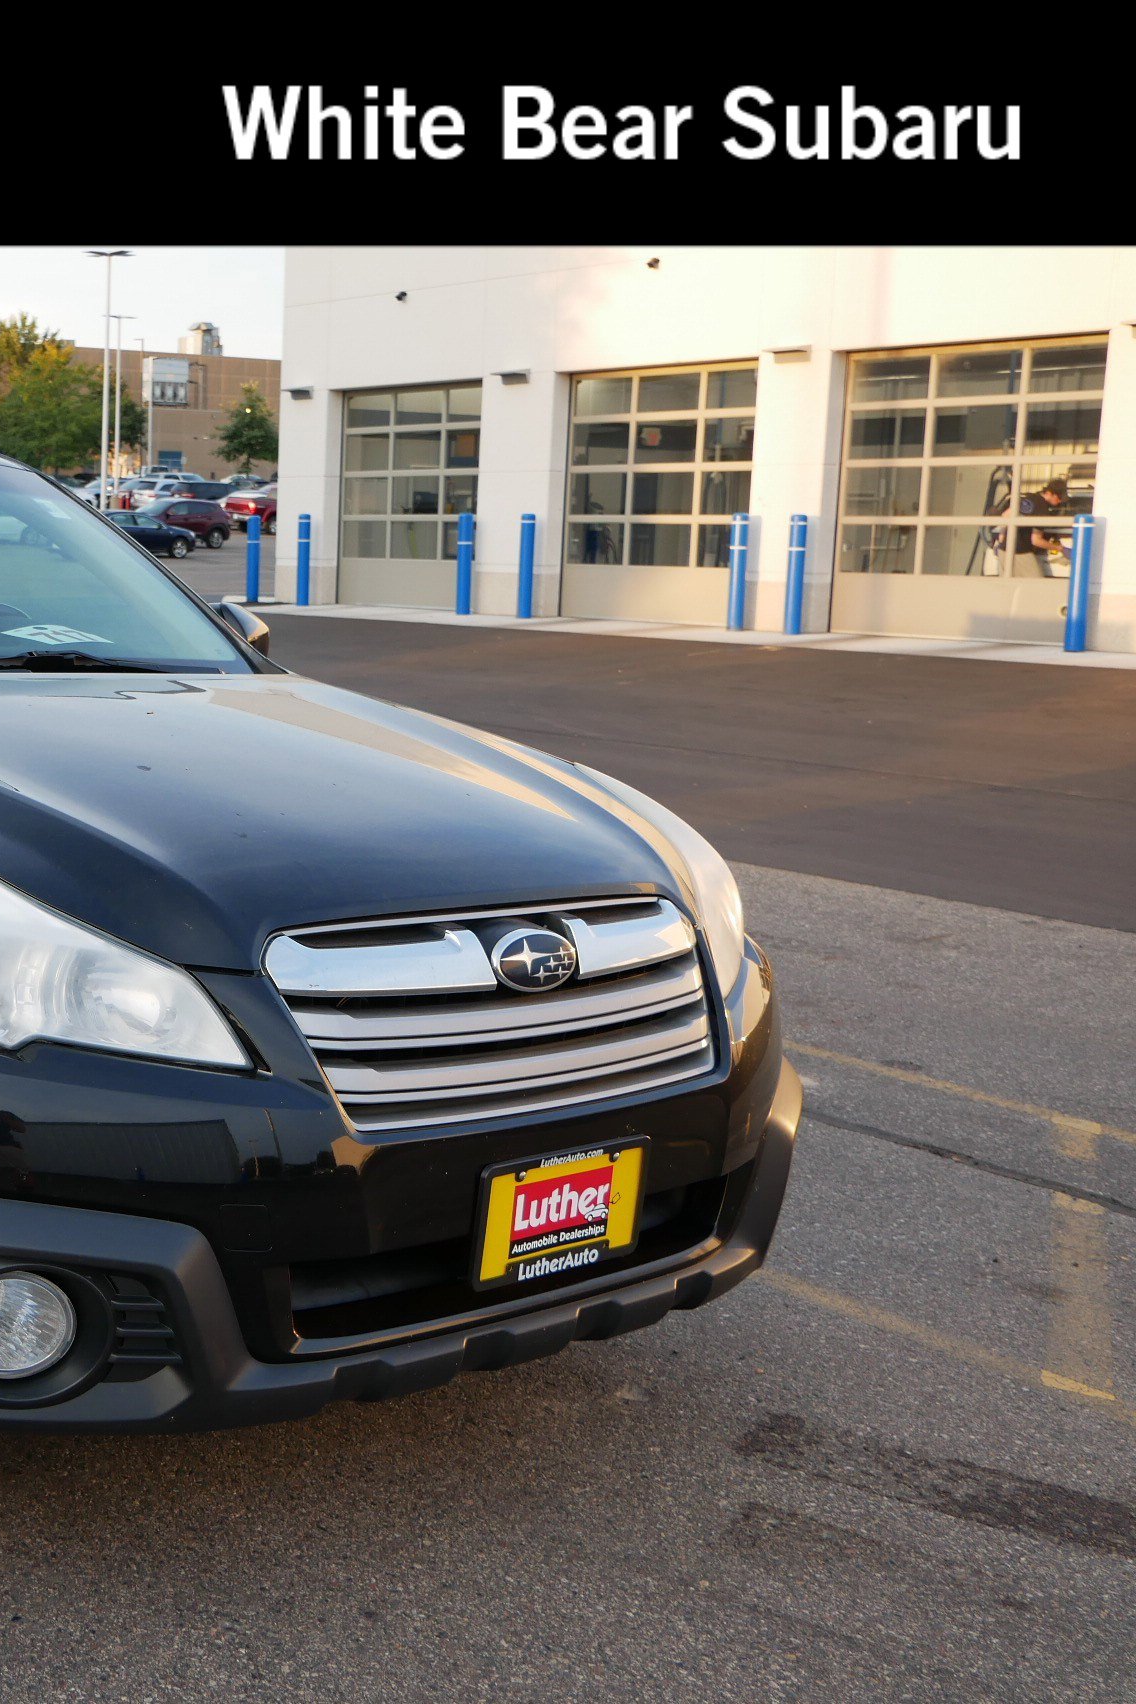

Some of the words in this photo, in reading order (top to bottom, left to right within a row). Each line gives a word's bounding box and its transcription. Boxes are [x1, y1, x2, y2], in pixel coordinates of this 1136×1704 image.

[540, 1149, 604, 1168] LutherAuto.com
[514, 1183, 611, 1232] Luther
[511, 1233, 558, 1255] Automobile
[559, 1224, 605, 1242] Dealerships
[517, 1248, 599, 1282] LutherAuto
